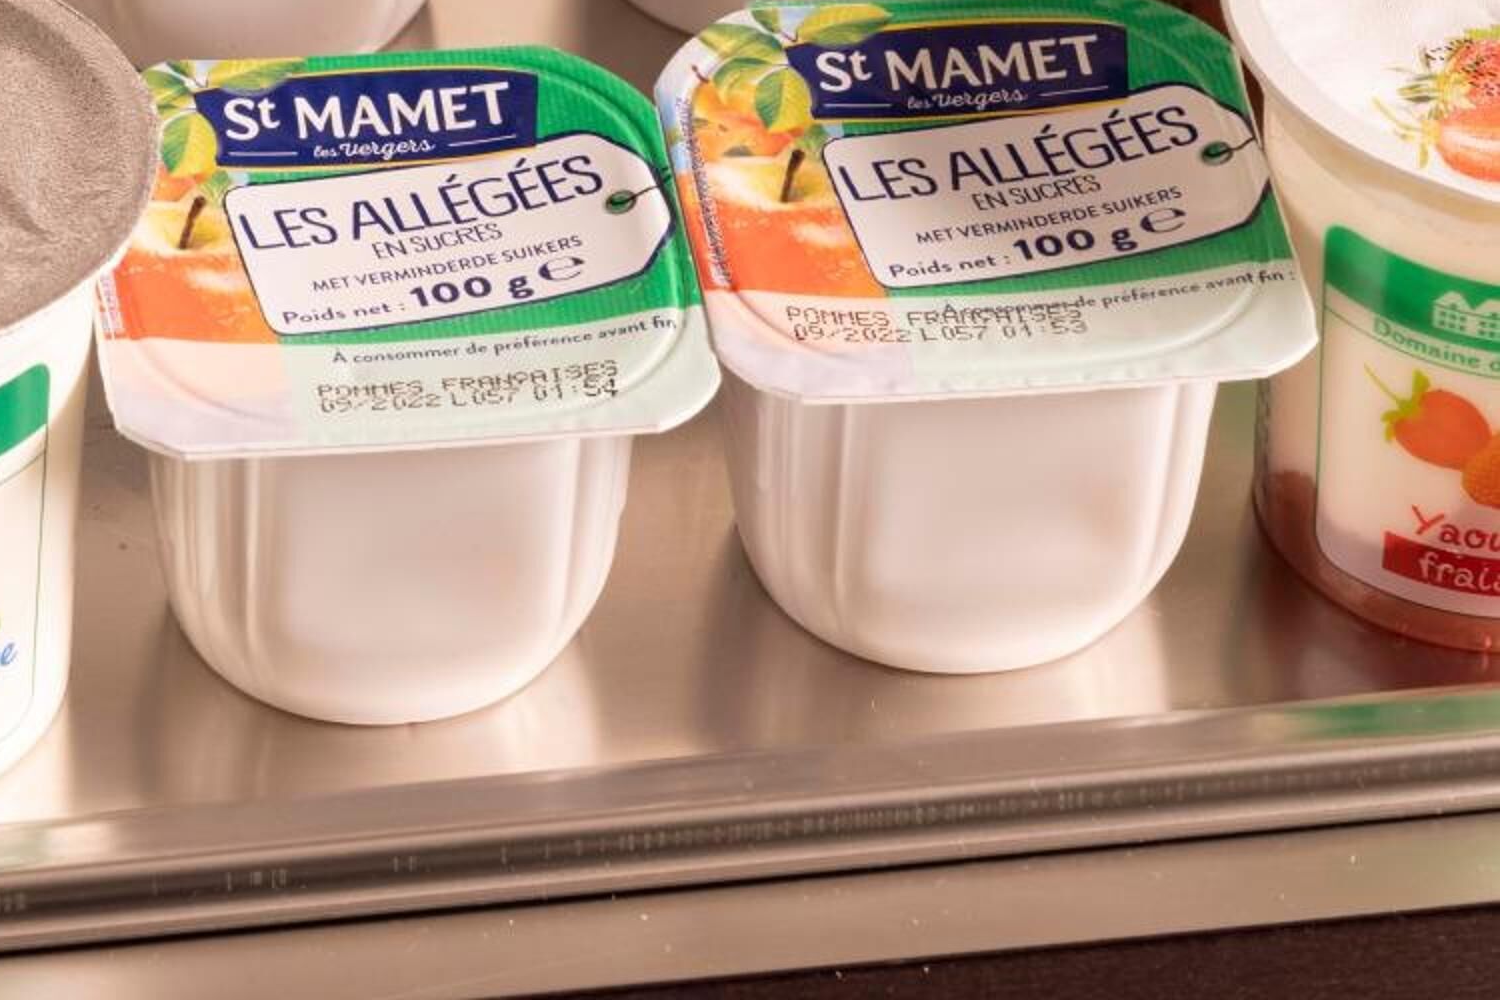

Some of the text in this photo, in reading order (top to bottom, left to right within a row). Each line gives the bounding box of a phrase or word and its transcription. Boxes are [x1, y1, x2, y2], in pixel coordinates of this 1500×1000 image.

[816, 34, 1098, 93] St MAMET
[223, 81, 509, 141] St MAMET
[314, 146, 338, 159] les
[838, 106, 1199, 201] LES ALLÉGÉES
[239, 154, 603, 250] LES ALLÉGÉES
[916, 186, 1182, 245] MET VERMINDERDE SUIKERS
[972, 174, 1101, 211] EN SUCRES
[313, 236, 583, 292] MET VERMINDERDE SUIKERS
[372, 223, 503, 259] EN SUCRES
[889, 228, 1138, 279] Poids net 100 g
[282, 275, 534, 325] Poids net 100 g
[1101, 283, 1200, 310] préférence
[1205, 273, 1255, 291] avant
[1258, 269, 1284, 284] fin
[786, 305, 890, 327] POMMES
[921, 325, 987, 342] L057
[353, 347, 460, 363] consommer
[466, 341, 488, 355] de
[493, 332, 594, 357] préférence
[598, 321, 647, 339] avant
[1373, 316, 1481, 369] Domaine
